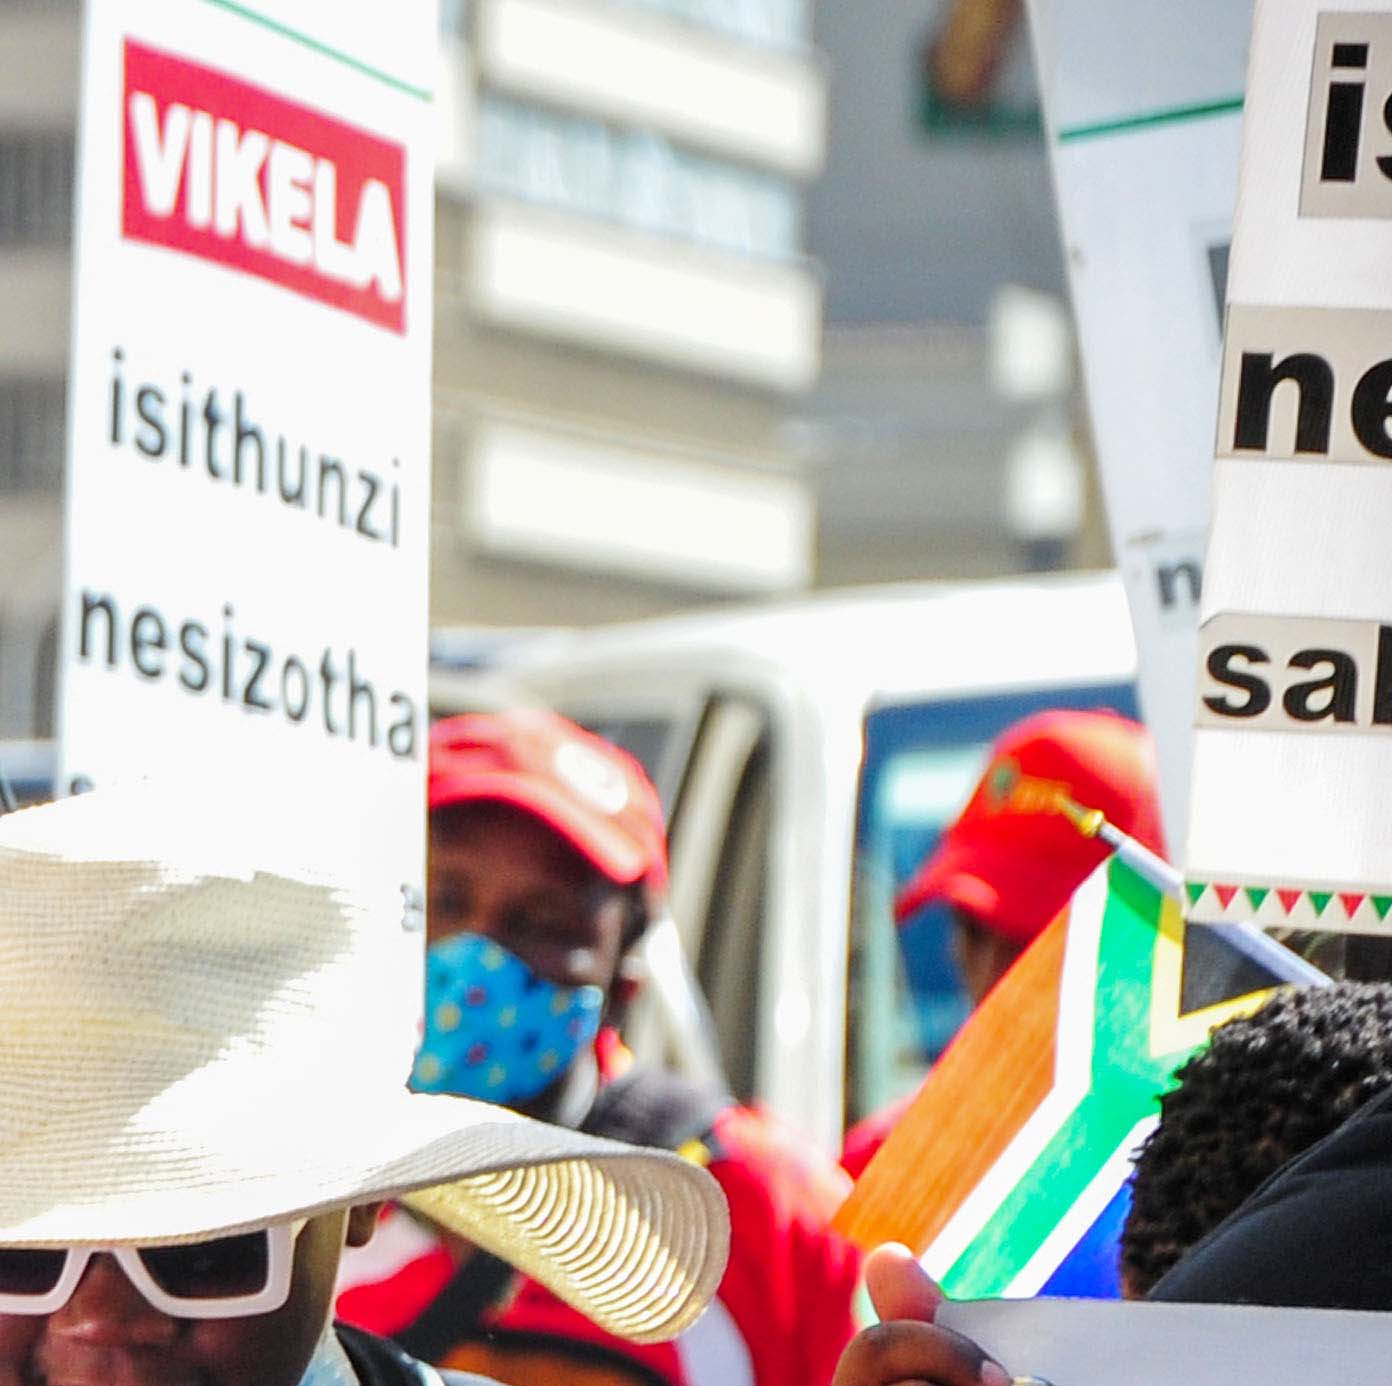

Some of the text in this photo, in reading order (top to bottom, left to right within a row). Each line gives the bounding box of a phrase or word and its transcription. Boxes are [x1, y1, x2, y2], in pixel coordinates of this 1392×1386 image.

[130, 91, 402, 303] VIKELA
[1320, 42, 1392, 186] i
[110, 345, 402, 549] isithunzi
[78, 588, 418, 761] nesizotha
[1202, 623, 1392, 726] sa
